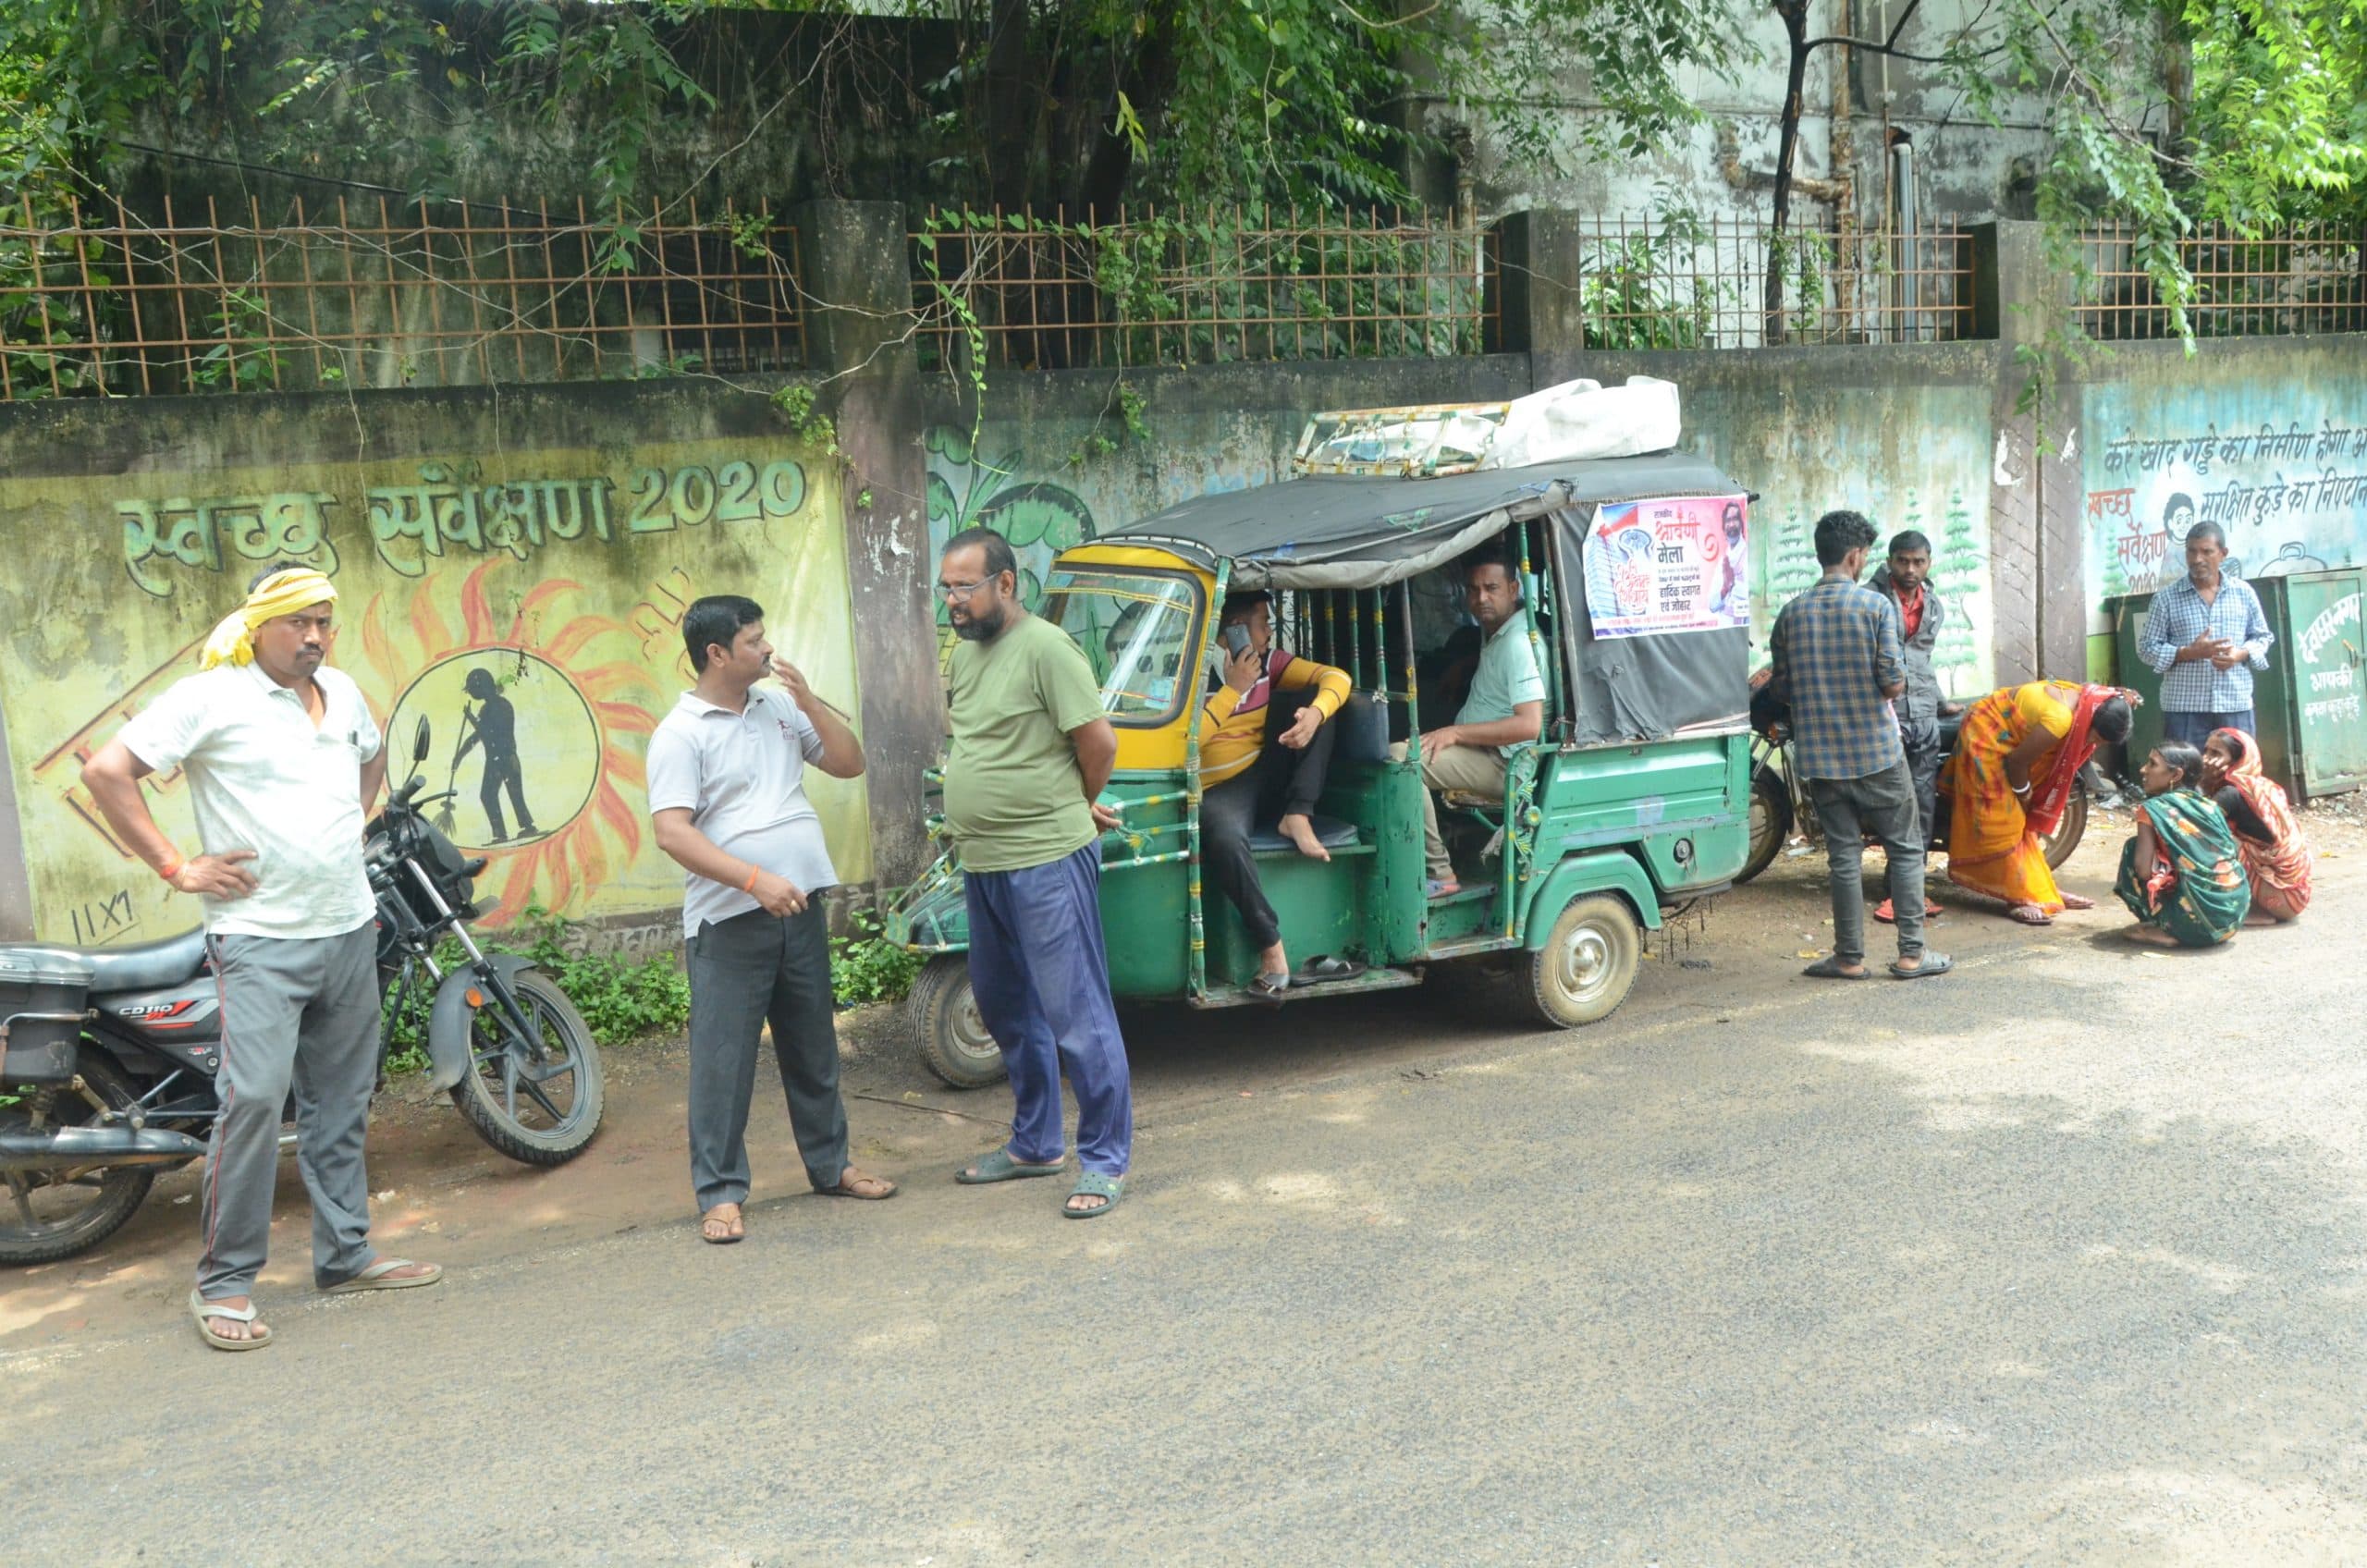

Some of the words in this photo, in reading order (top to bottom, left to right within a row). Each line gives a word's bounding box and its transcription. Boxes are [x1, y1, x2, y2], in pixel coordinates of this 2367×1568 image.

[2219, 435, 2252, 466] का
[630, 460, 806, 534] 2020
[2287, 481, 2316, 515] का
[1656, 542, 1684, 564] मेला
[1659, 582, 1680, 598] हार्दिक
[1681, 584, 1701, 597] स्वागत
[1660, 599, 1670, 612] एवं
[1671, 598, 1691, 612] जोहार
